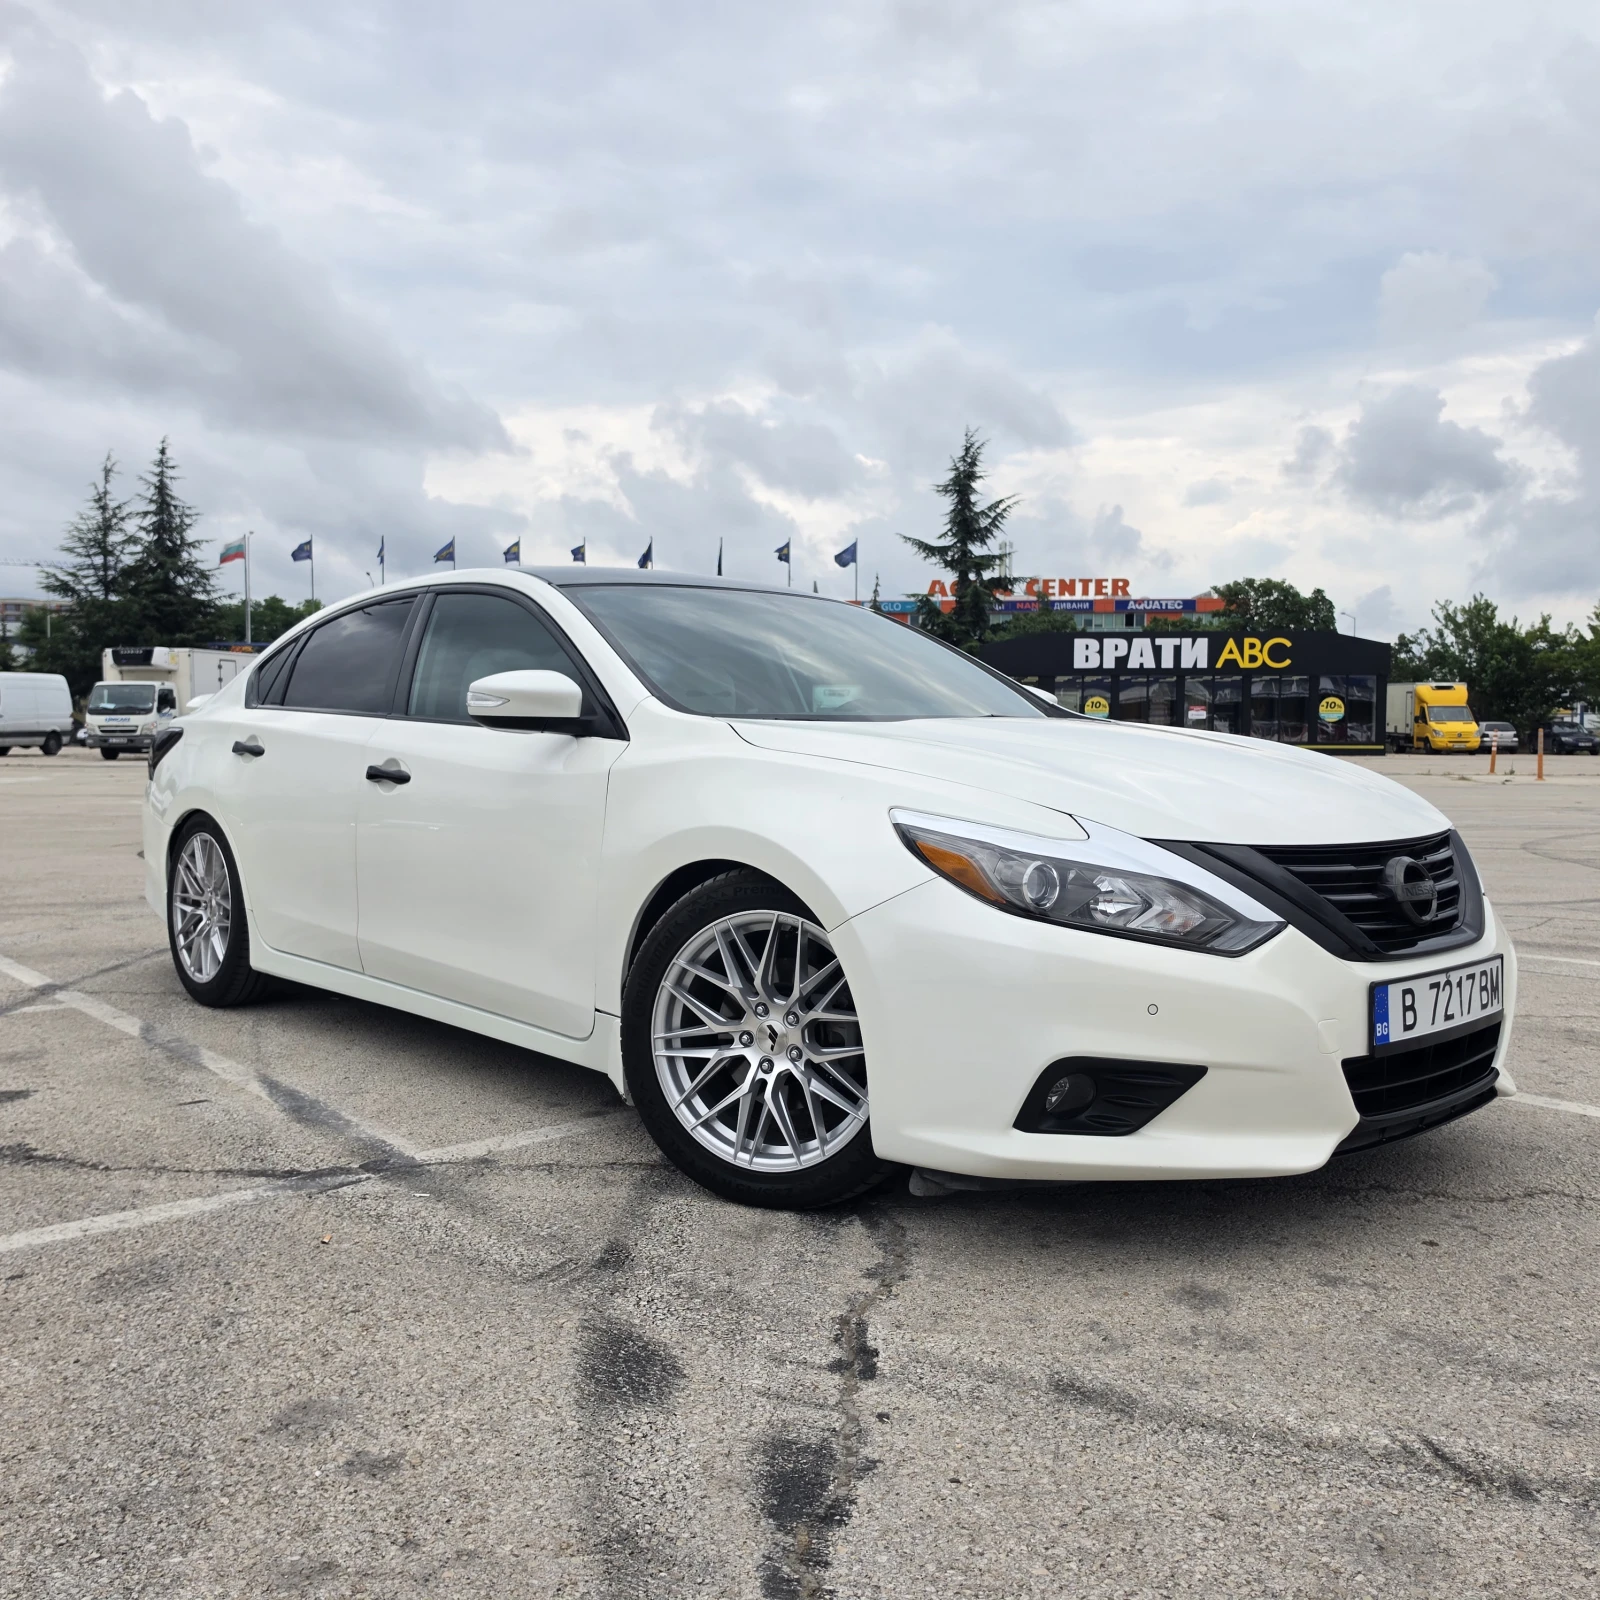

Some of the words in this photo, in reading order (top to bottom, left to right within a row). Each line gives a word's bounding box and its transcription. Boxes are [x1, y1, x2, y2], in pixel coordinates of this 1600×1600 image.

[1025, 578, 1130, 597] CENTER
[1053, 602, 1090, 611] ДИВАНИ
[1127, 600, 1184, 611] AQUATEC
[1073, 637, 1209, 670] ВРАТИ
[1215, 637, 1292, 669] ABC
[1086, 701, 1108, 709] -10%
[1320, 701, 1343, 710] -10%
[1404, 884, 1437, 898] NISSA
[1401, 987, 1418, 1033] B
[1376, 1022, 1389, 1037] BG
